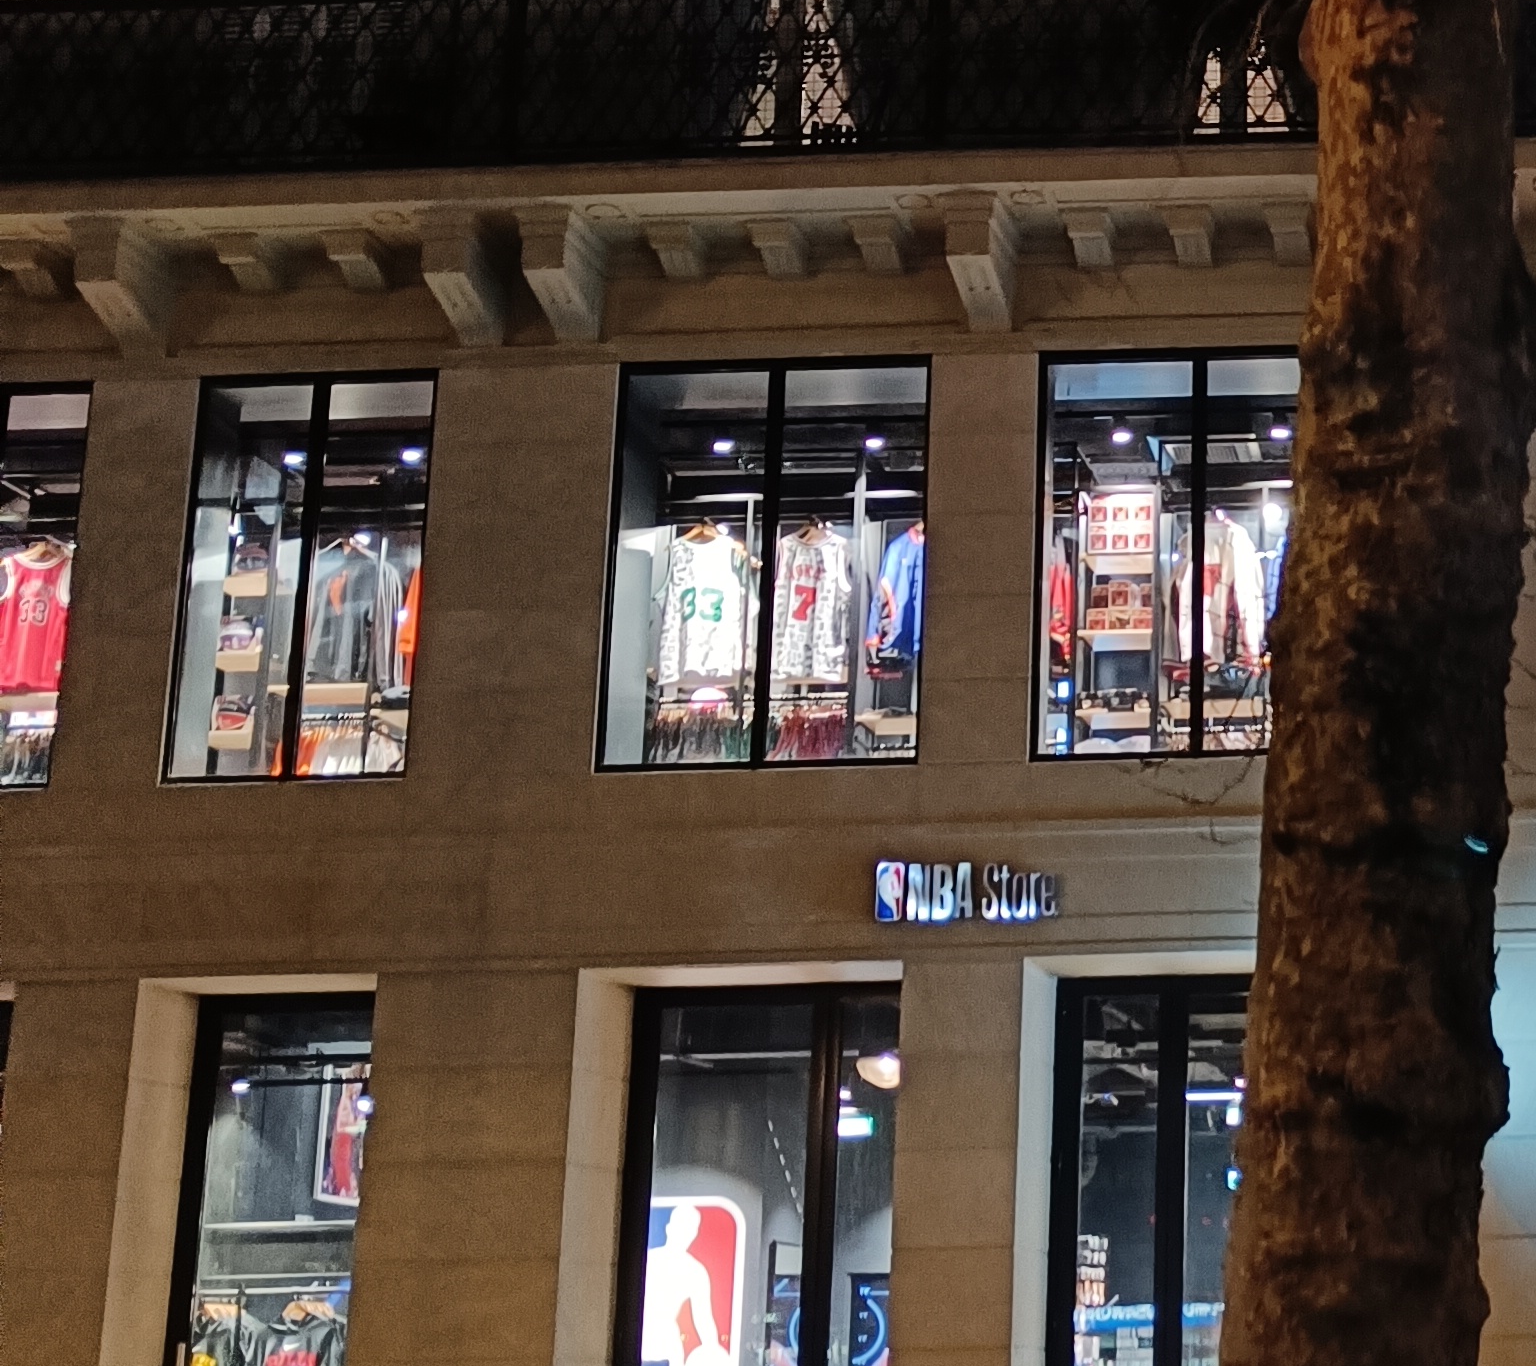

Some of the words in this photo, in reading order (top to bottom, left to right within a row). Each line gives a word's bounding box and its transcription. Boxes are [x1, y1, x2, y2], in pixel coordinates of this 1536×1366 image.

[792, 584, 817, 622] 7
[906, 862, 973, 922] NBA
[981, 862, 1057, 921] Store
